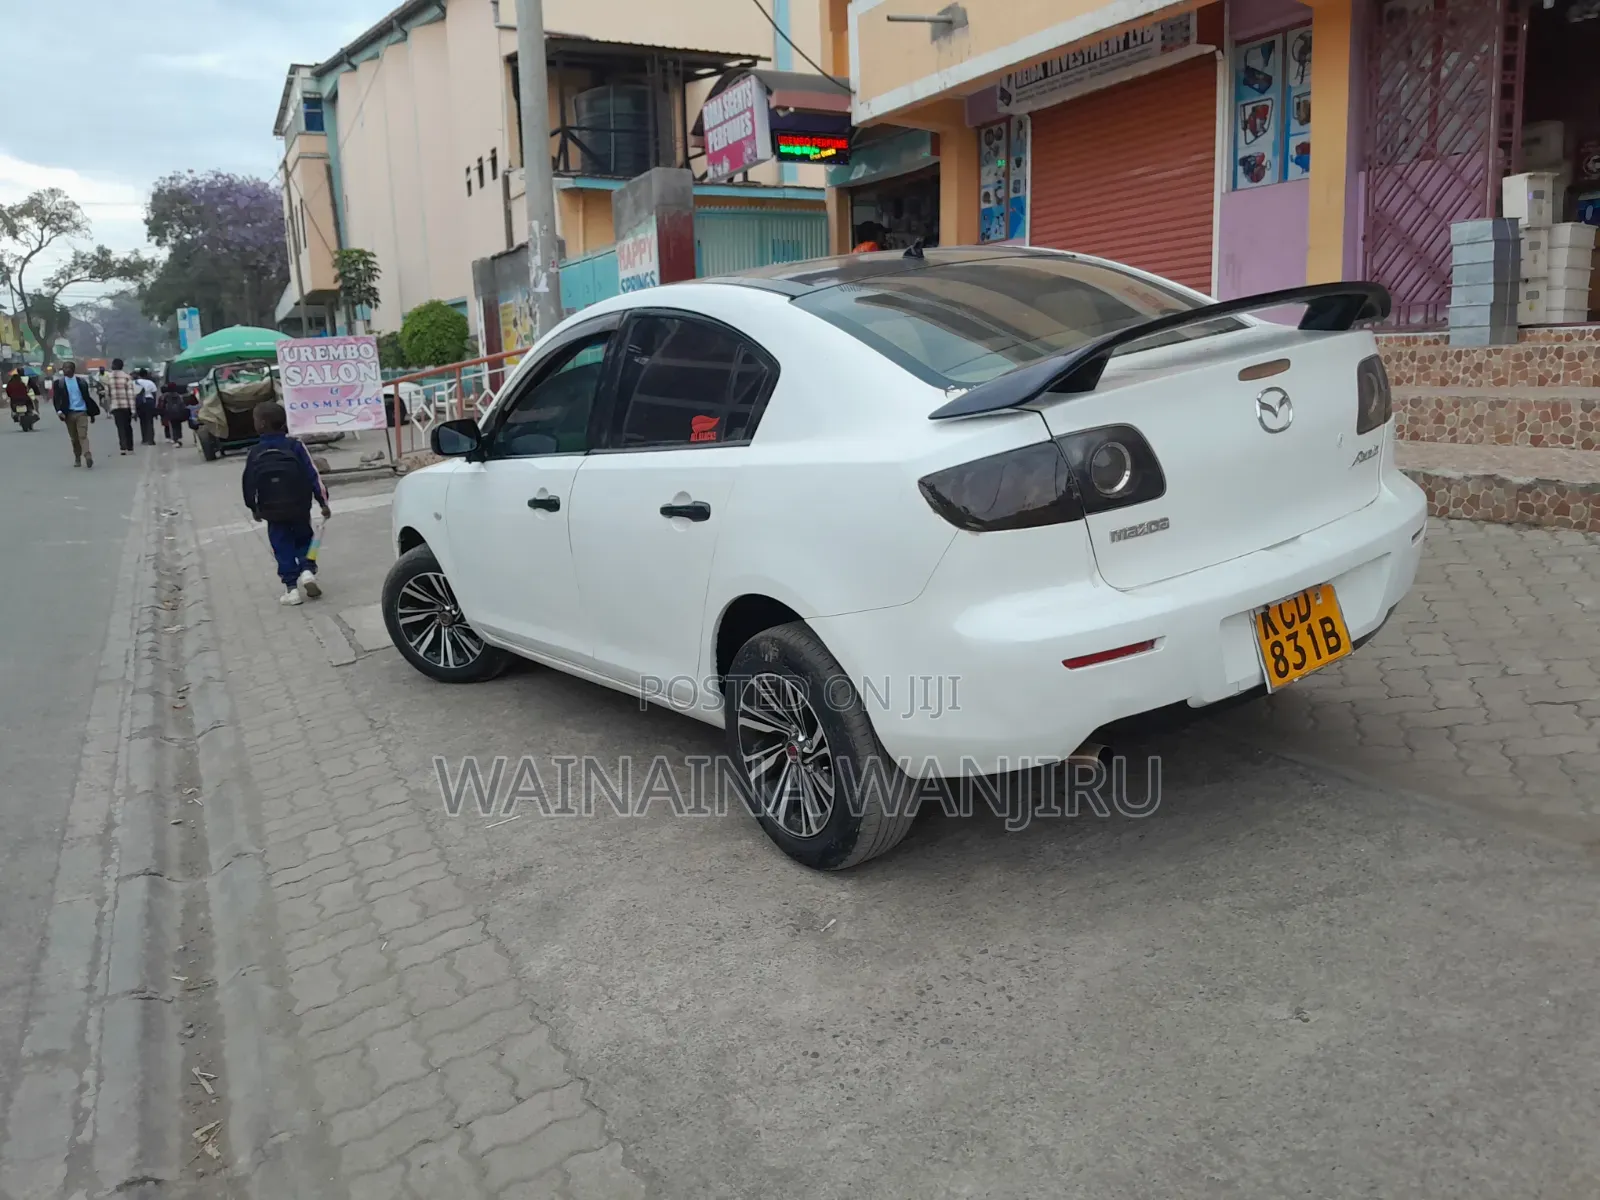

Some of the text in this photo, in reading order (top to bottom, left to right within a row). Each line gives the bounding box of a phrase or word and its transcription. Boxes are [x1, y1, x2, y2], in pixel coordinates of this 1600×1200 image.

[1049, 32, 1127, 75] INVESTMENT
[618, 234, 653, 272] HAPPY
[282, 343, 375, 362] UREMBO
[285, 361, 378, 387] SALON
[289, 397, 382, 410] COSMETICS
[1260, 592, 1311, 640] KCD
[1270, 616, 1342, 679] 831B
